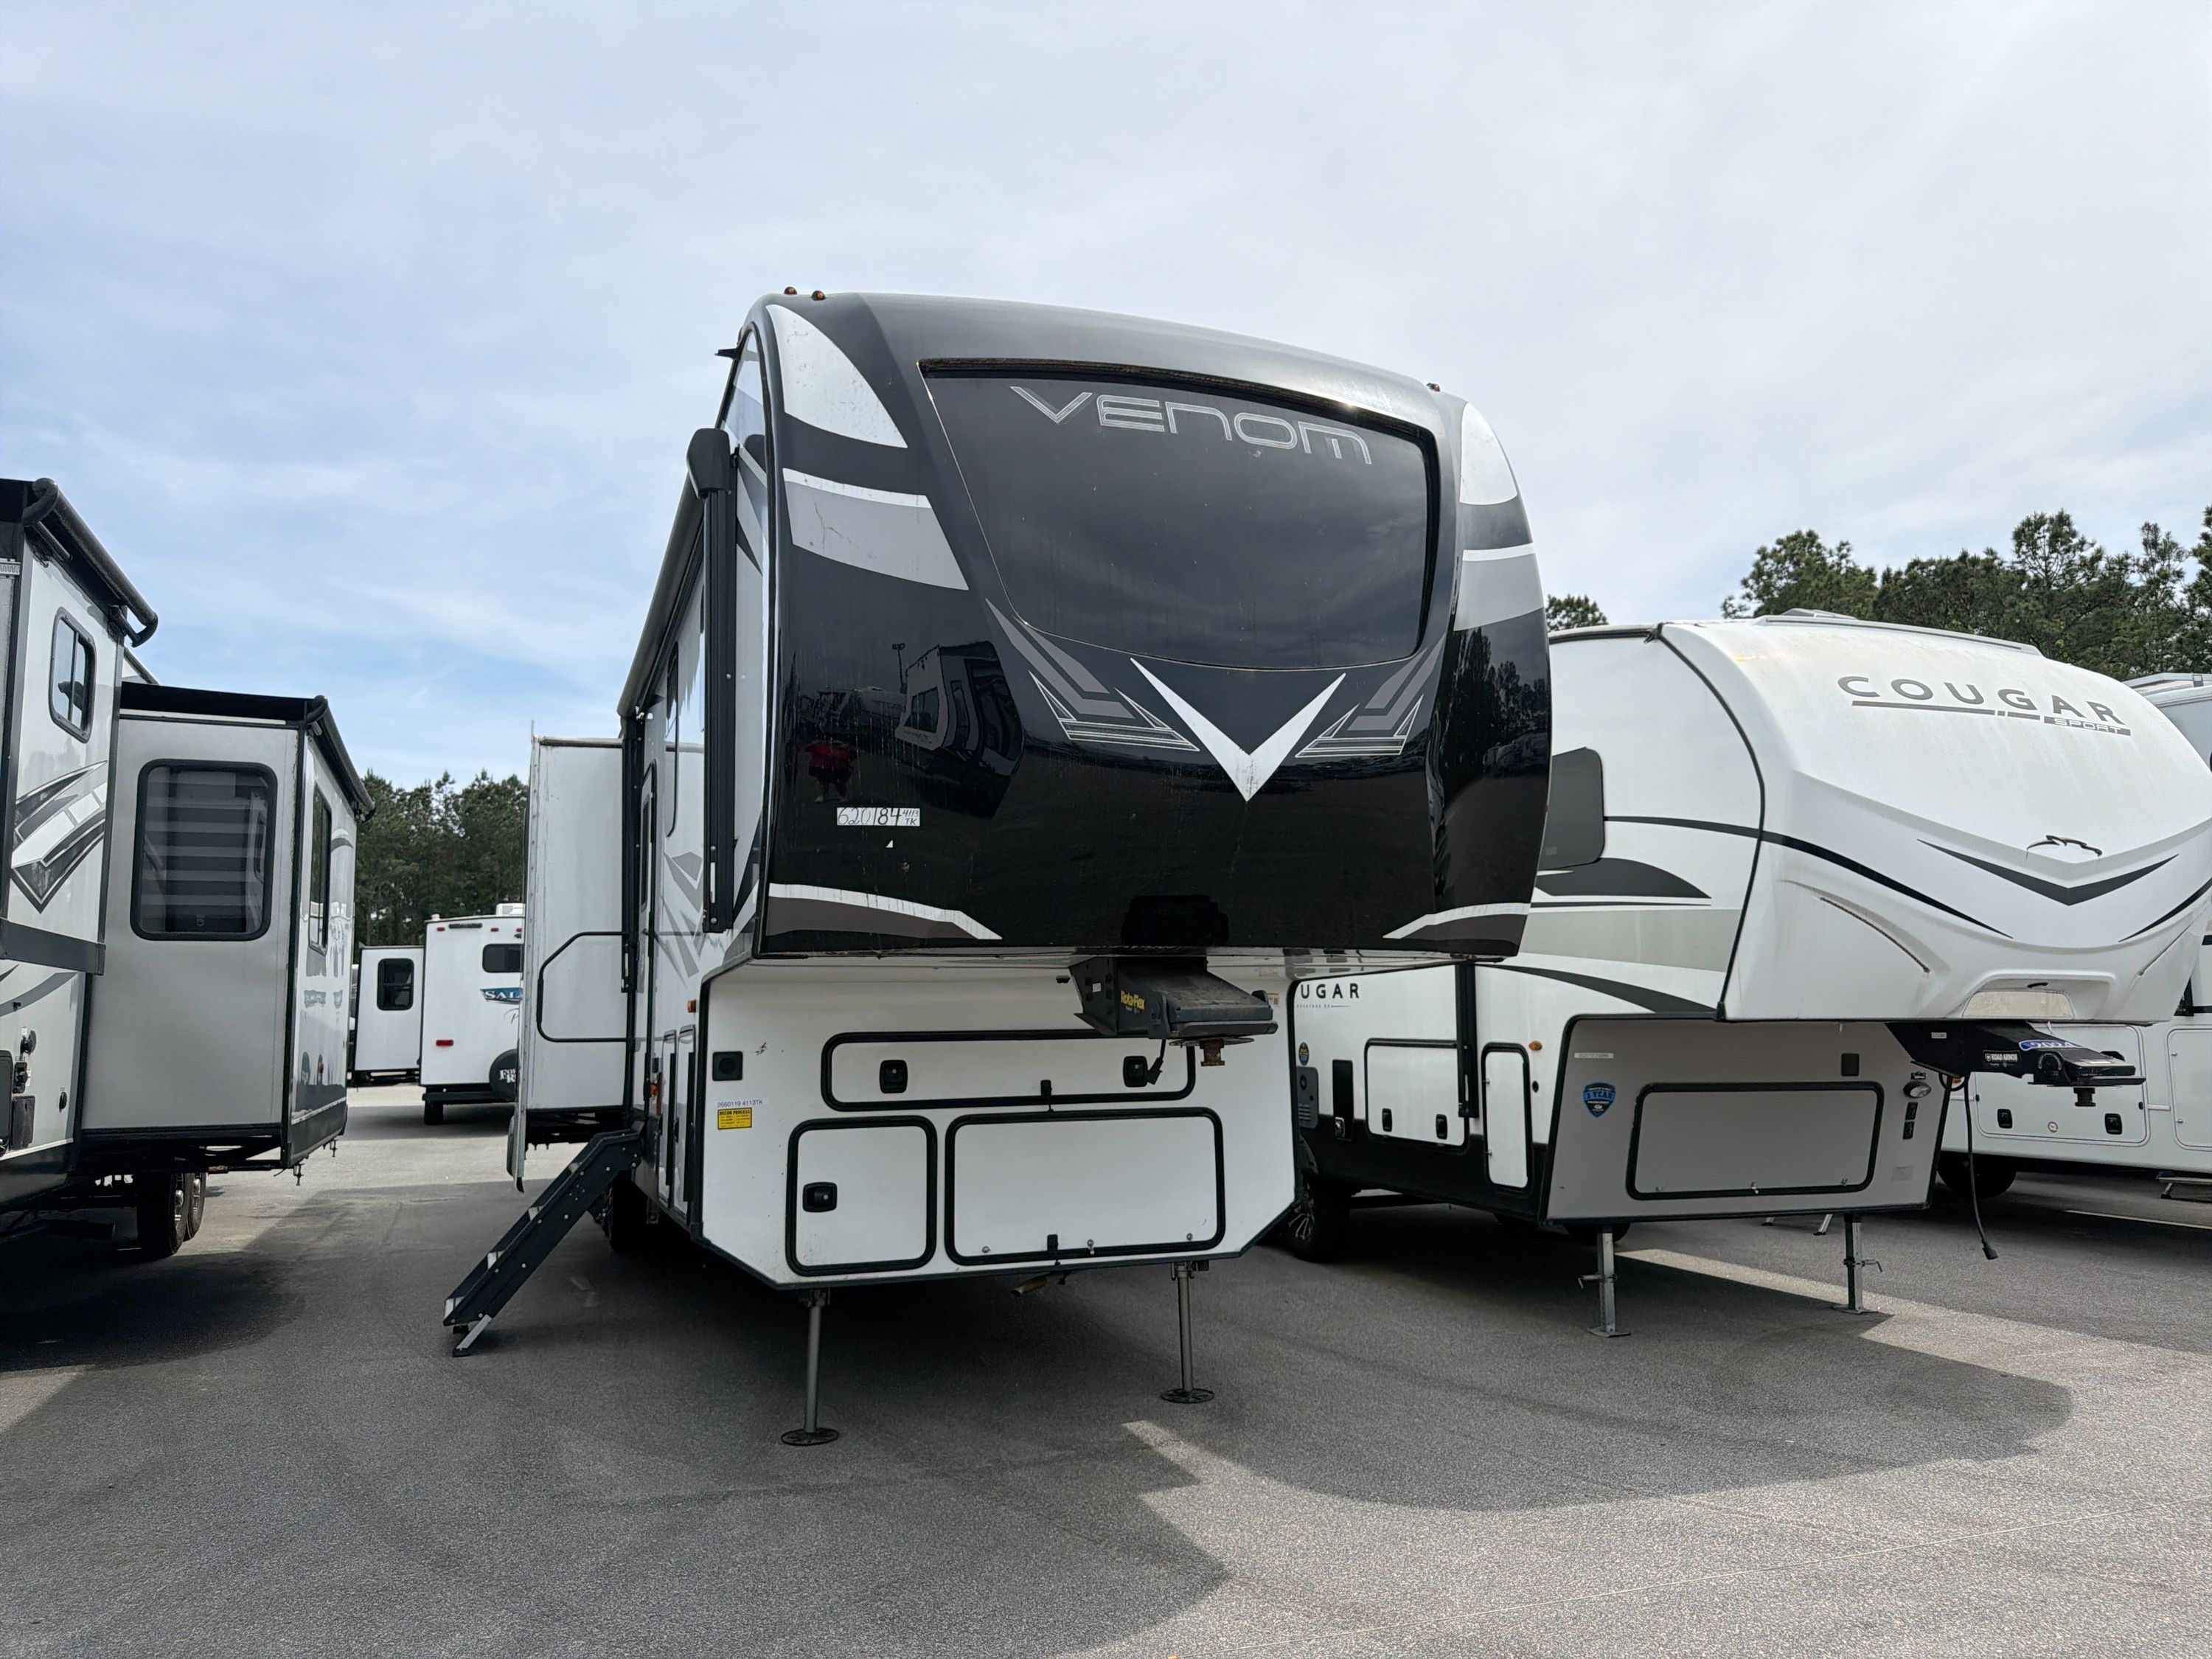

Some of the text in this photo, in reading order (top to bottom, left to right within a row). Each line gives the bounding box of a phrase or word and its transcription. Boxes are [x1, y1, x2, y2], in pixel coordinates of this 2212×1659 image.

[1010, 386, 1372, 465] VENOM
[1833, 675, 2126, 726] COUGAR
[2053, 717, 2123, 733] SPORT
